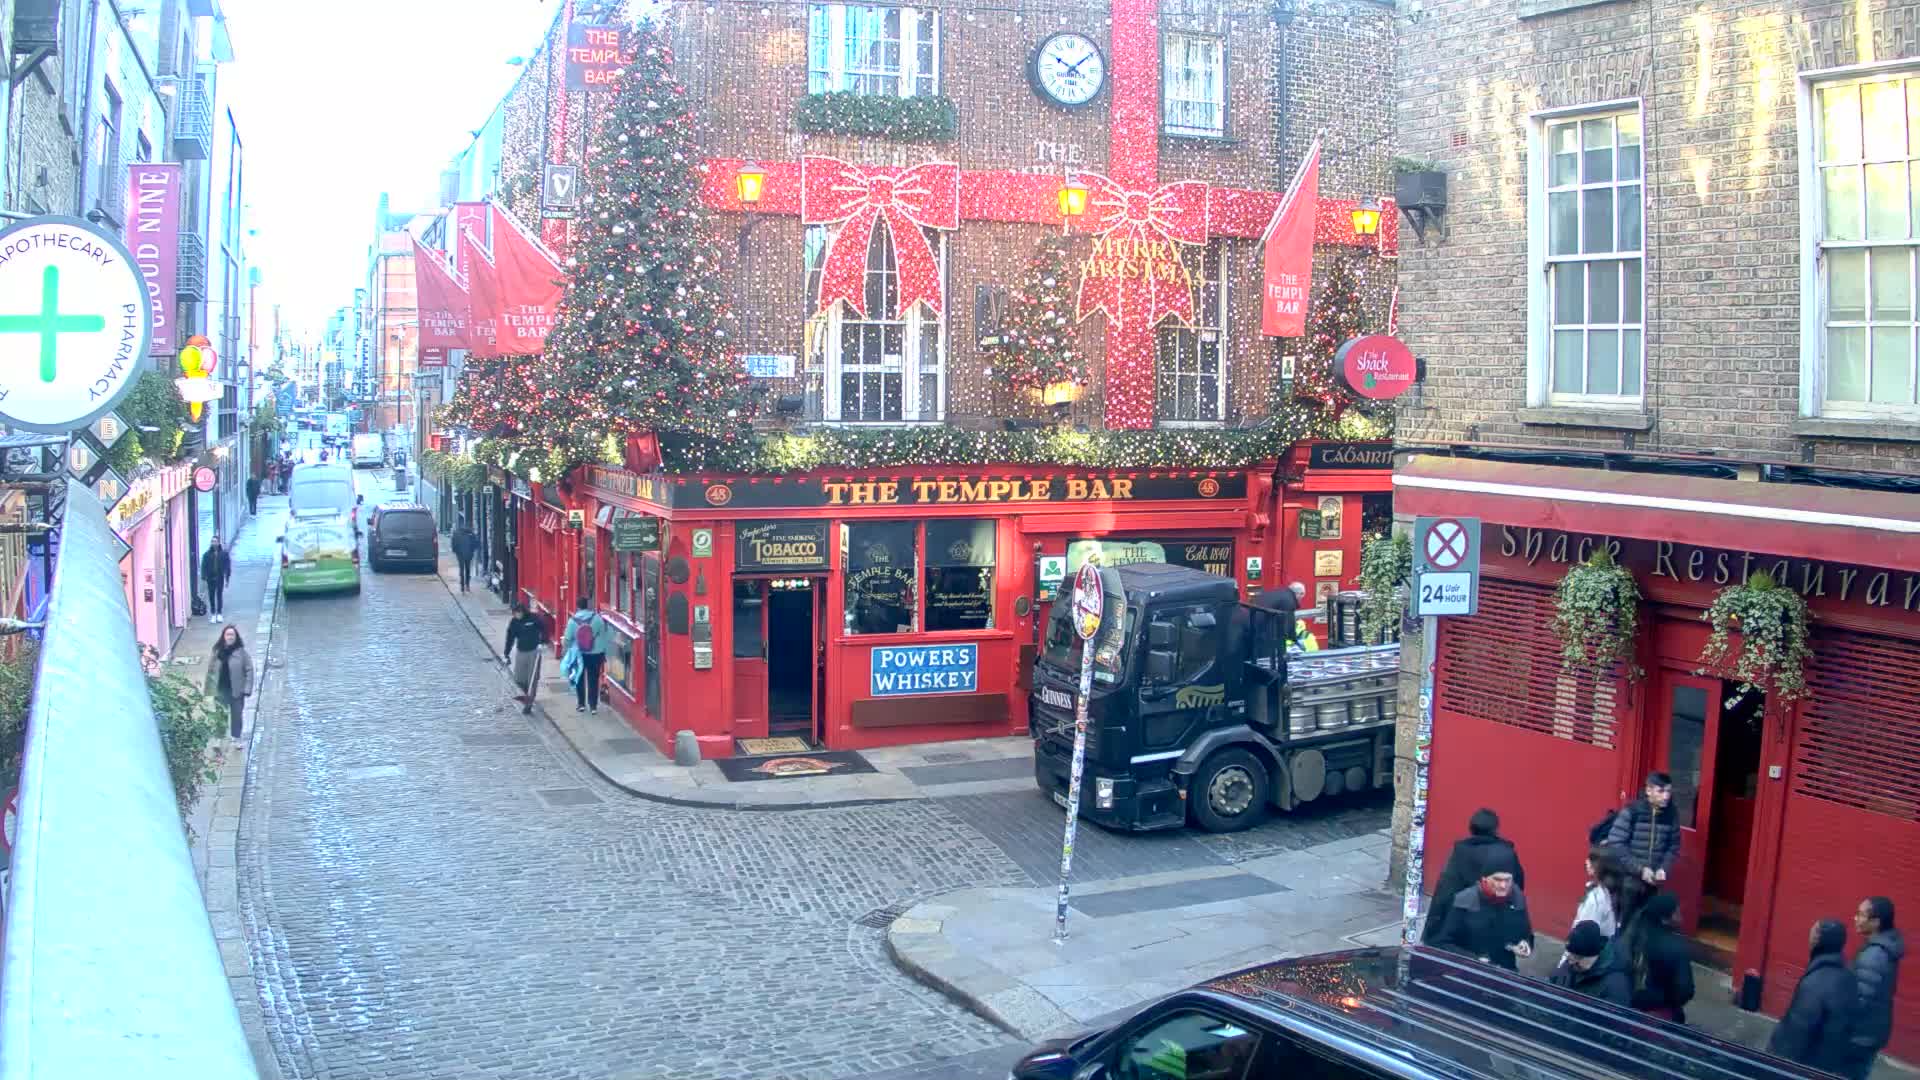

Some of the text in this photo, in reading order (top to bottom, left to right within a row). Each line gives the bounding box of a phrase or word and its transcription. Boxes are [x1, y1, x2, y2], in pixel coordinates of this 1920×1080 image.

[585, 29, 619, 45] THE
[1034, 140, 1083, 163] THE
[137, 170, 170, 233] NINE
[1090, 237, 1181, 263] MERRY
[1280, 274, 1298, 285] THE
[1268, 283, 1304, 300] TEMPL
[519, 304, 545, 314] THE
[1276, 301, 1300, 314] BAR
[503, 314, 557, 326] TEMPL
[516, 326, 549, 337] BAR
[89, 302, 137, 402] PHARMACY
[824, 479, 1134, 504] THE TEMPLE BAR
[752, 539, 817, 563] TOBACCO
[1123, 546, 1148, 558] THE
[1422, 584, 1443, 603] 24
[1445, 594, 1467, 603] HOUR
[880, 648, 970, 668] POWER'S
[874, 671, 975, 690] WHISKEY
